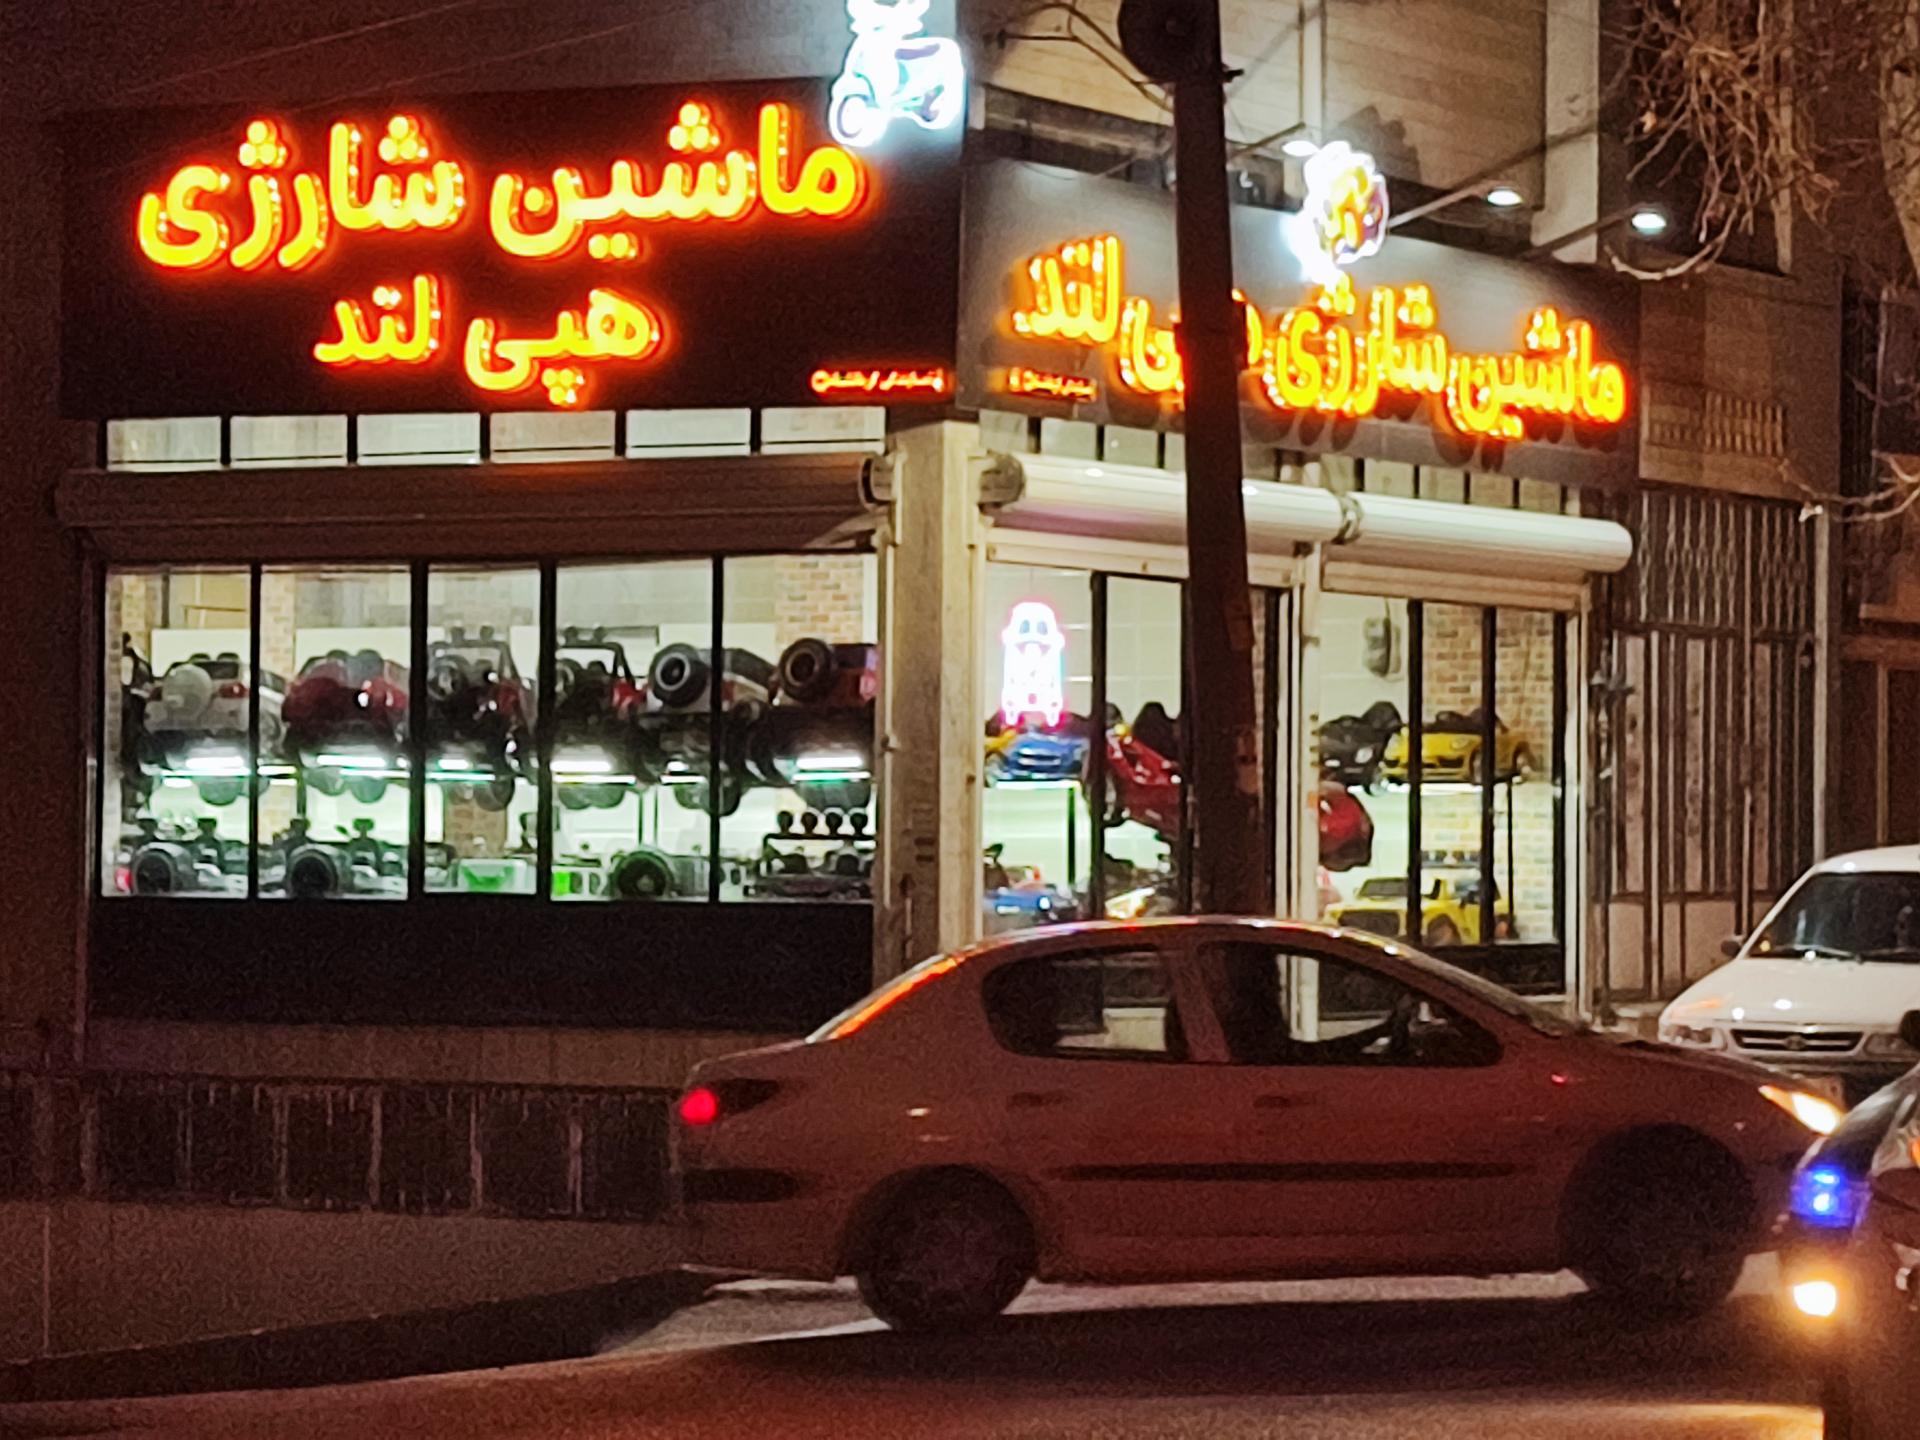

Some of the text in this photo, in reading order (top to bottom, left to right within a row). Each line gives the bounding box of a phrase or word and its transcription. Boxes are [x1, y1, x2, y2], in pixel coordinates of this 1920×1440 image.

[138, 102, 862, 268] ماشین شارژی
[314, 275, 655, 406] هپی لند
[1018, 236, 1118, 343] لند
[1269, 273, 1448, 416] شارژی
[1453, 309, 1626, 438] ماشین
